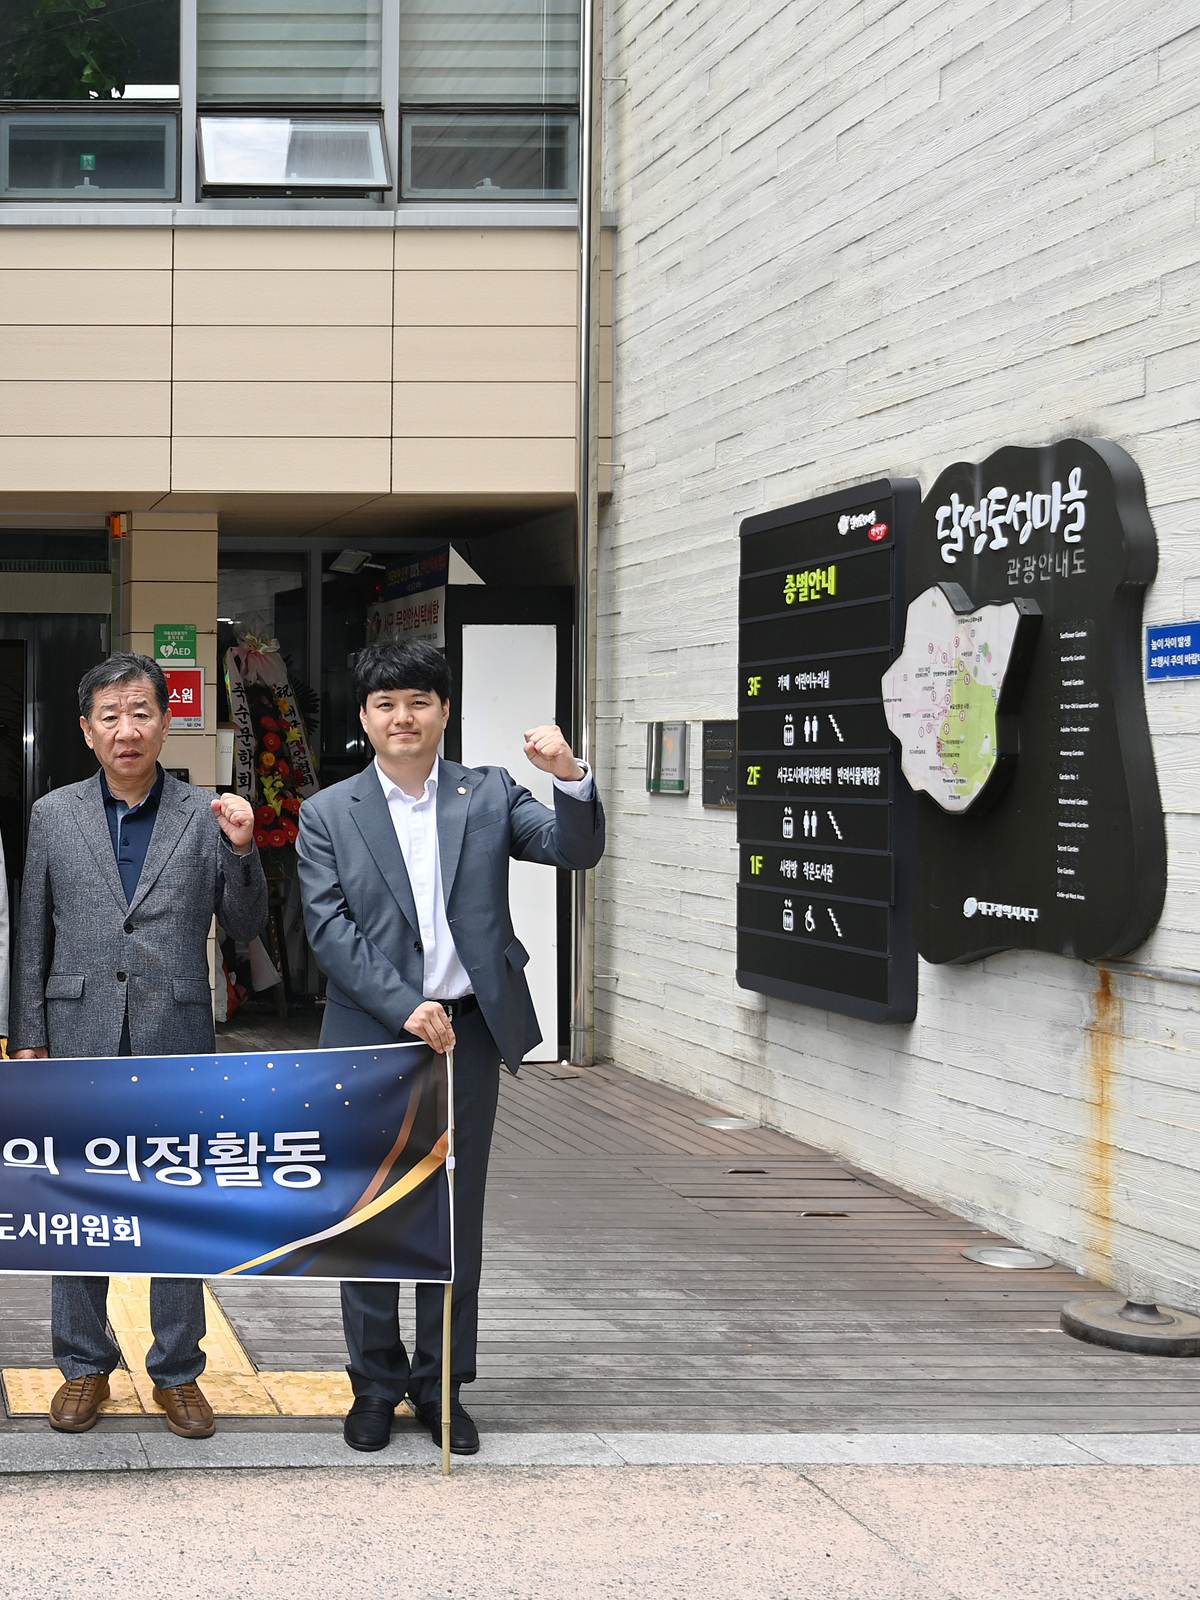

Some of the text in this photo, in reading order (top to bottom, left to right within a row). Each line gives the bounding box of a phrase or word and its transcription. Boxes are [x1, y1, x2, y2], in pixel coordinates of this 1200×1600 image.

[935, 467, 1088, 564] 달성토성마을
[1006, 549, 1086, 585] 관광안내도
[783, 565, 836, 605] 층별안내
[172, 648, 191, 656] AED
[1150, 635, 1191, 650] 높이 차이 발생
[1150, 653, 1200, 668] 보행시 주의 바랍
[169, 688, 193, 704] 스원
[747, 670, 830, 697] 3F 카페 어린이누리실
[747, 766, 761, 785] 2F
[750, 855, 834, 883] 1F 사랑방 작은도서관
[84, 1130, 327, 1189] 의정활동
